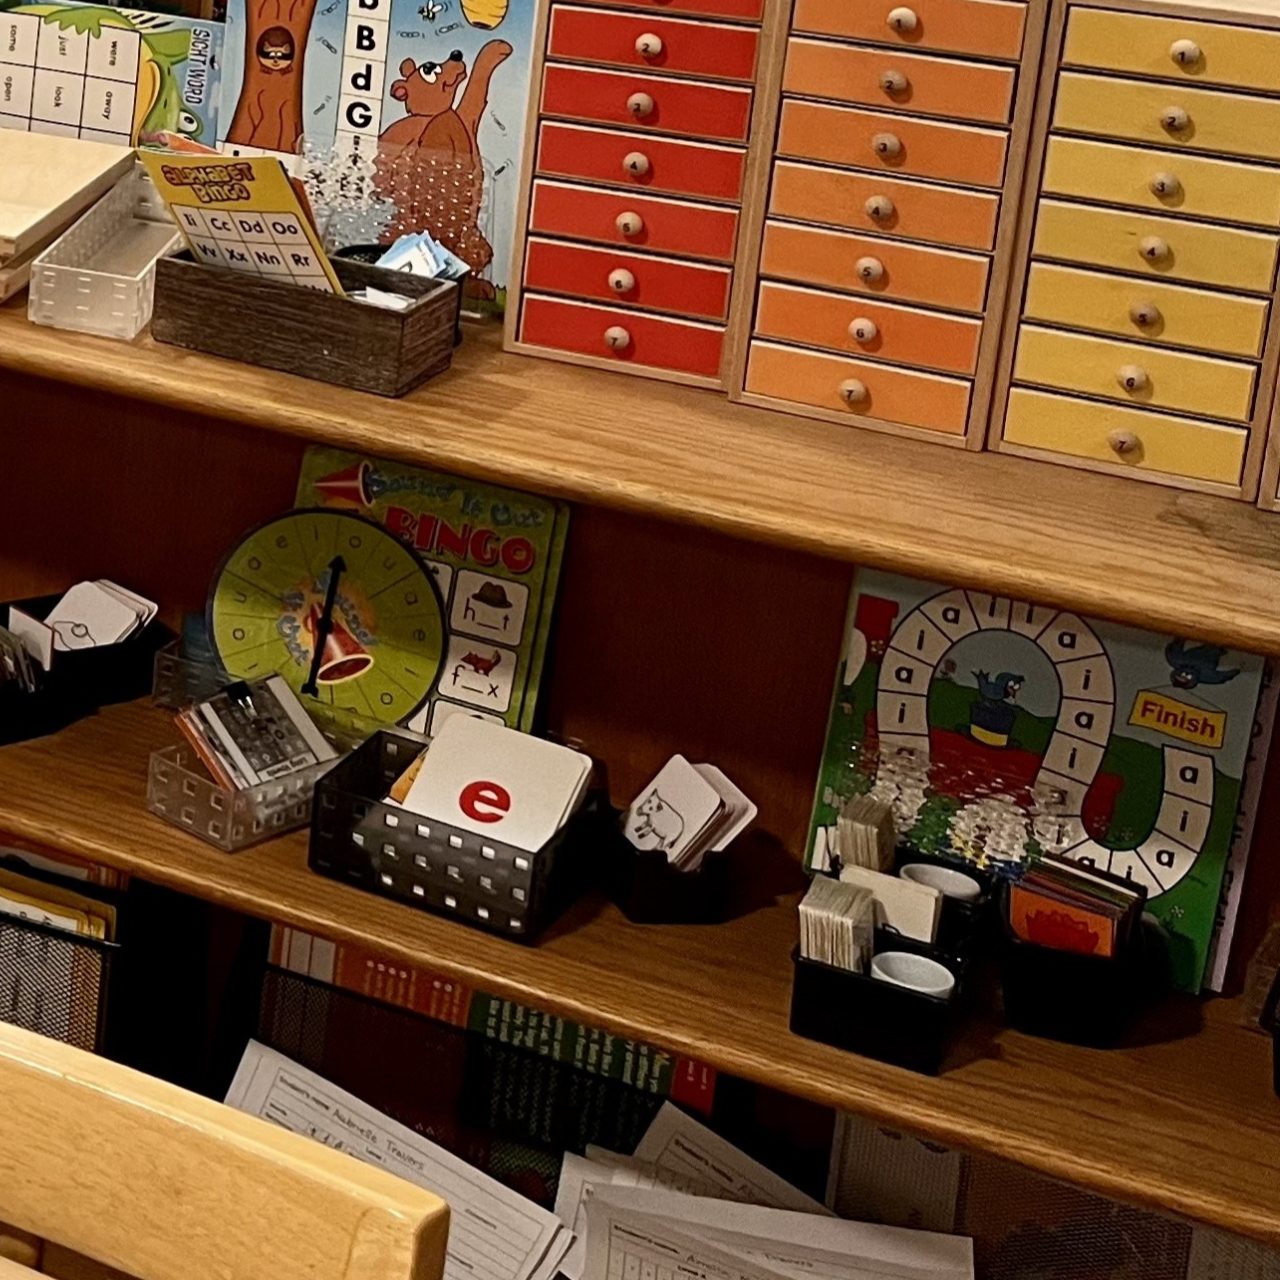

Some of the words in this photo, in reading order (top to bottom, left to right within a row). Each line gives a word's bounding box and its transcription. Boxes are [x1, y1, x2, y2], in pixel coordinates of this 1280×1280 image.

[58, 35, 67, 57] just
[109, 40, 118, 66] were
[190, 27, 210, 64] SIGHT
[356, 25, 376, 52] B
[185, 65, 205, 106] WORD
[351, 64, 372, 91] d
[3, 76, 13, 102] open
[53, 86, 64, 107] look
[104, 91, 113, 120] away
[346, 102, 372, 129] G
[183, 213, 197, 228] Ii
[210, 217, 231, 233] Cc
[240, 220, 264, 235] Dd
[272, 221, 299, 236] Oo
[197, 243, 218, 258] Vv
[225, 248, 249, 264] Xx
[257, 251, 281, 267] Nn
[292, 253, 310, 268] Rr
[384, 504, 536, 575] BINGO
[942, 606, 961, 624] a
[1058, 630, 1077, 649] a
[894, 665, 914, 684] a
[1083, 669, 1091, 689] i
[898, 704, 906, 723] i
[1074, 710, 1095, 729] a
[1140, 699, 1217, 738] Finish
[1179, 764, 1199, 784] a
[458, 781, 511, 823] e
